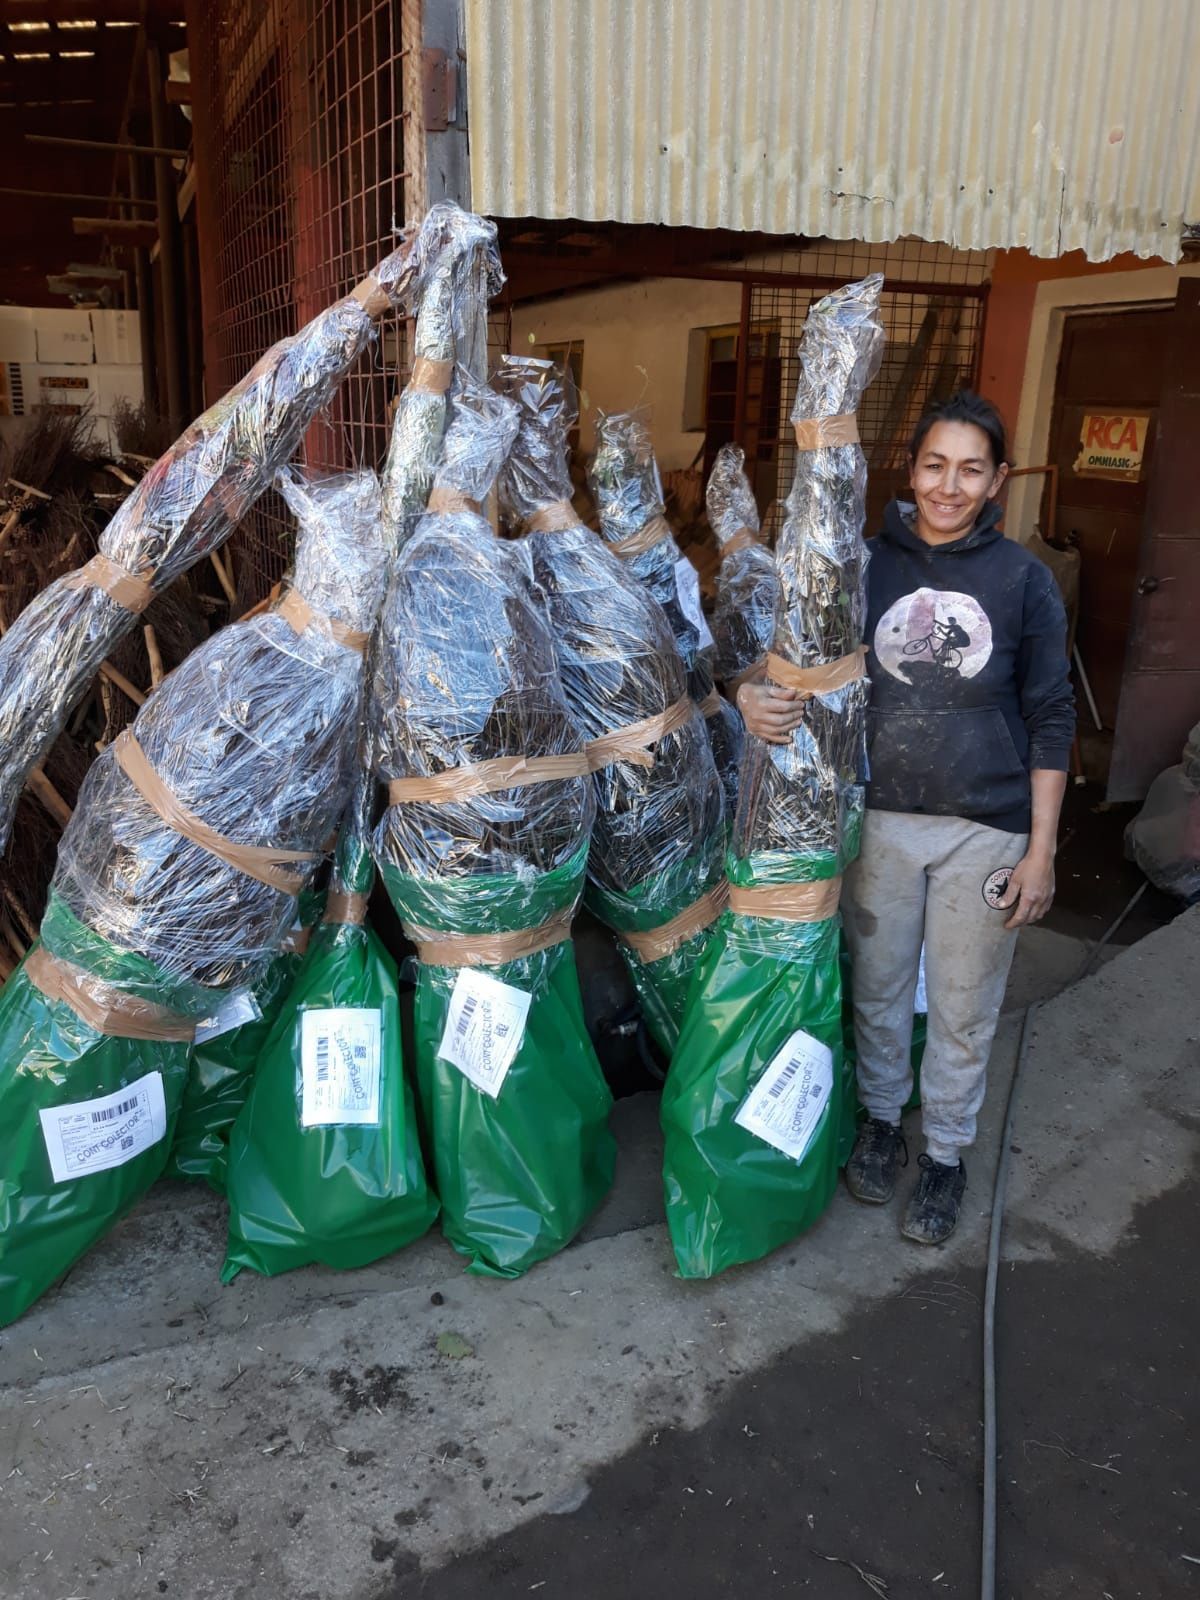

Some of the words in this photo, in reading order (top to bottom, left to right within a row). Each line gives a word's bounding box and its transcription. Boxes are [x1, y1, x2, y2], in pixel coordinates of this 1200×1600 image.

[1086, 417, 1138, 452] RCA
[990, 870, 1014, 884] CONVE
[797, 1068, 814, 1110] COLECTOR
[76, 1144, 101, 1162] CONT
[101, 1113, 141, 1149] COLECTOR
